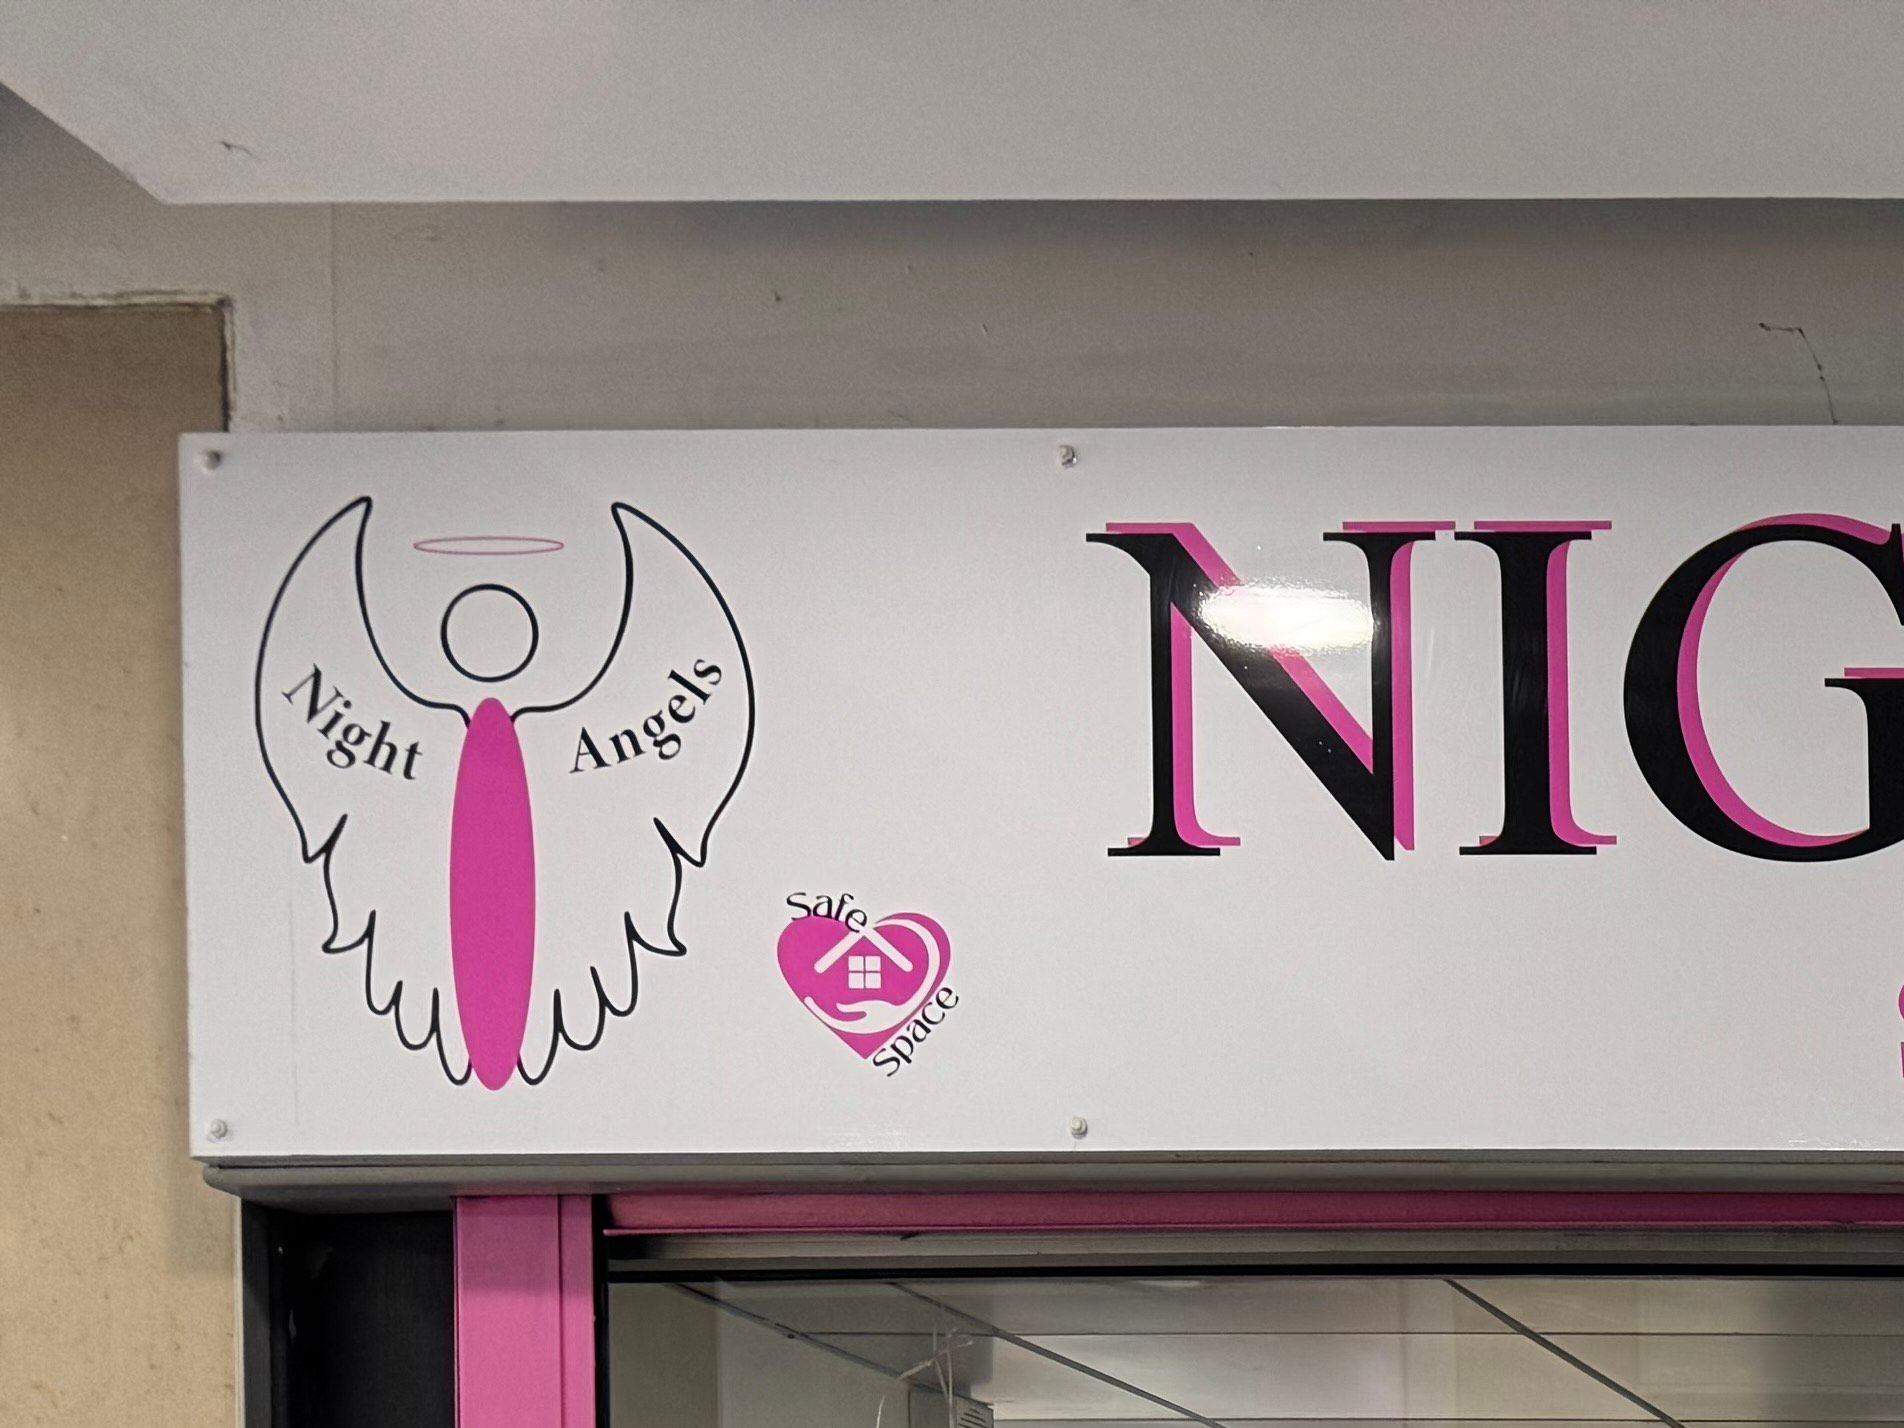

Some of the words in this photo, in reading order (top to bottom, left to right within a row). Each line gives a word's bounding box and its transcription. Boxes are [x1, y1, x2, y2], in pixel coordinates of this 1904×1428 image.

[282, 663, 424, 781] Night
[570, 657, 723, 774] Angels
[786, 891, 868, 933] Safe
[873, 986, 960, 1077] Space
